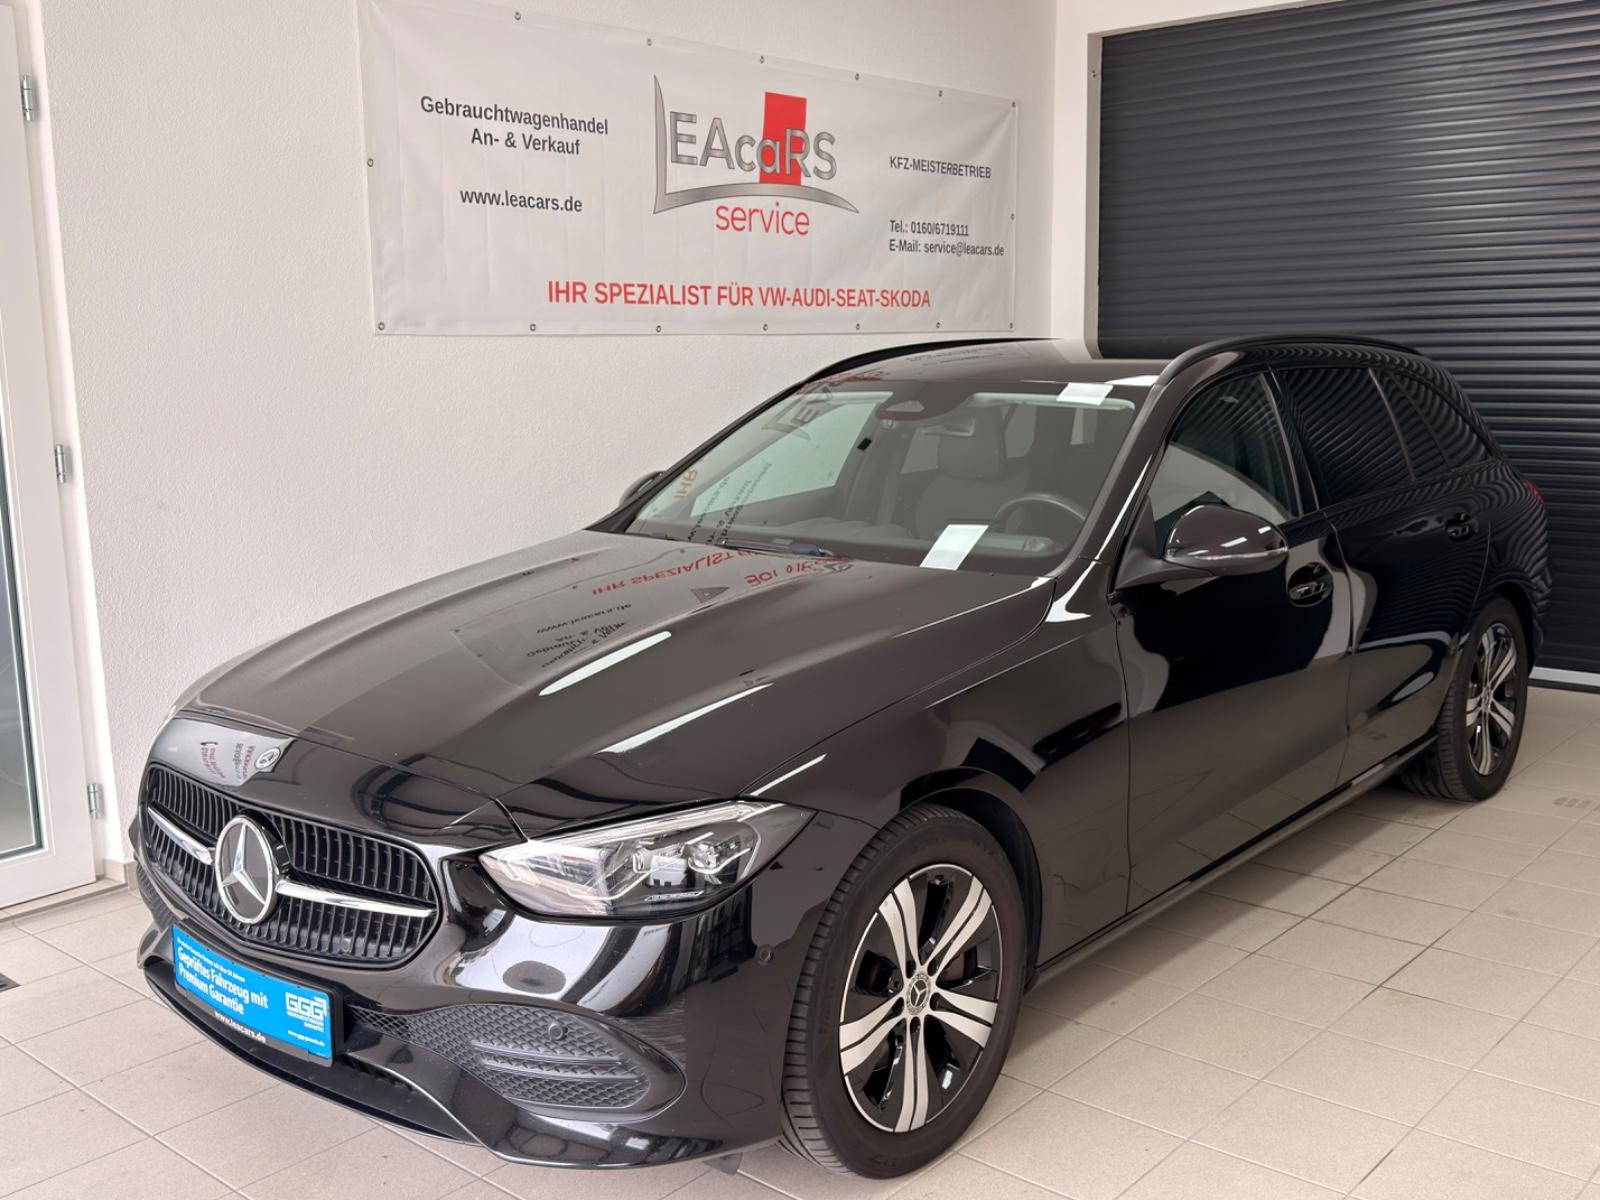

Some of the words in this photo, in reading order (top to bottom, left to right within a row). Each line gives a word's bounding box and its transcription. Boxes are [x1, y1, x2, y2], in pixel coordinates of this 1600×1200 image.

[420, 96, 608, 135] Gebrauchtwagenhandel
[471, 128, 500, 146] An-
[504, 132, 517, 149] &
[522, 133, 580, 155] Verkauf
[889, 156, 992, 178] KFZ-MEISTERBETRIEB
[460, 190, 583, 212] www.leacars.de
[715, 201, 810, 236] service
[889, 220, 909, 234] Tel.:
[910, 221, 969, 237] 0160/6719111
[889, 239, 922, 254] E-Mail:
[923, 241, 1005, 257] service@leacars.de
[548, 280, 588, 304] IHR
[594, 282, 711, 306] SPEZIALIST
[717, 282, 754, 307] FÜR
[759, 286, 931, 308] VW-AUDI-SEAT-SKODA
[177, 946, 212, 980] Geprüftes
[211, 967, 250, 1003] Fahrzeug
[250, 991, 269, 1009] mit
[178, 962, 210, 995] Premium
[209, 984, 245, 1016] Garantie
